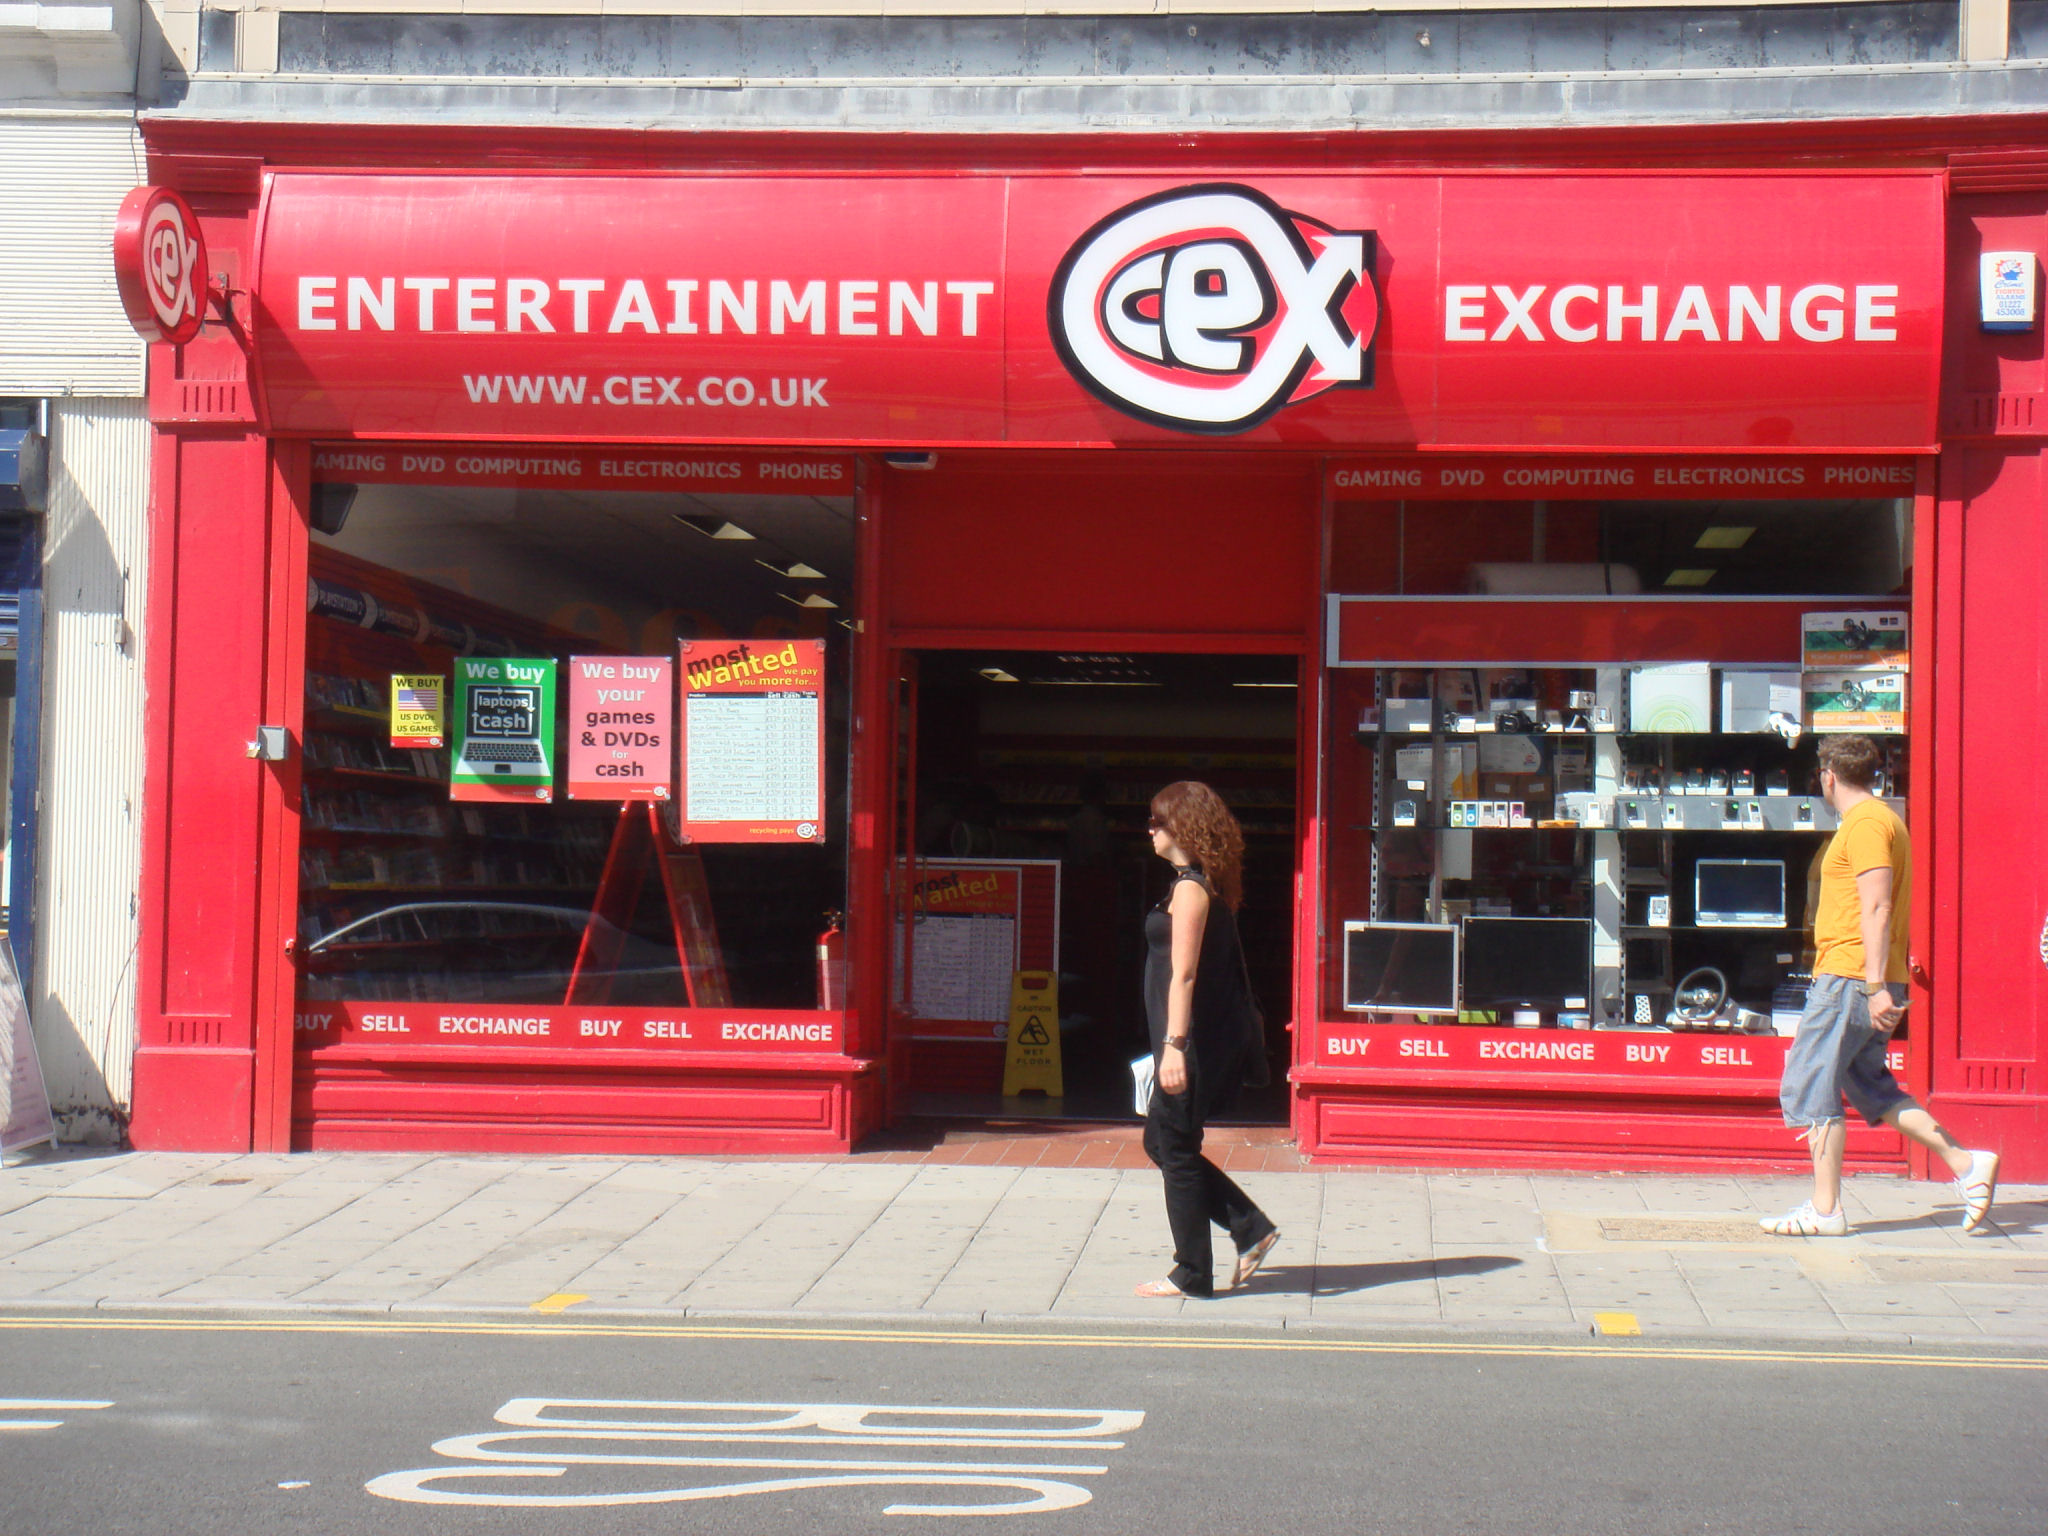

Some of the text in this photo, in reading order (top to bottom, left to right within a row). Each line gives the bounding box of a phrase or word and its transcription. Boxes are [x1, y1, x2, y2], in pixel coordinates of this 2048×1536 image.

[298, 276, 995, 338] ENTERTAINMENT
[1444, 285, 1899, 342] EXCHANGE
[463, 374, 830, 408] WWW.CEX.CO.UK
[314, 454, 843, 480] AMING DVD COMPUTING ELECTRONICS PHONES
[1334, 466, 1915, 487] GAMING DVD COMPUTING ELECTRONICS PHONES
[687, 644, 750, 675] most
[688, 643, 798, 690] wanted
[466, 663, 545, 683] We buy
[582, 663, 661, 683] We buy
[800, 668, 818, 677] pay
[395, 678, 440, 688] WE BUY
[739, 678, 756, 687] you
[759, 677, 793, 686] more
[478, 695, 529, 709] laptops
[597, 689, 645, 705] your
[400, 713, 435, 721] US DVDs
[479, 713, 526, 729] cash
[586, 712, 655, 728] games
[396, 725, 438, 733] US GAMES
[581, 731, 660, 747] & DVDs
[611, 750, 629, 759] for
[595, 762, 644, 777] cash
[749, 827, 778, 835] recycling
[295, 1014, 833, 1042] BUY SELL EXCHANGE BUY SELL EXCHANGE
[1328, 1038, 1752, 1066] BUY SELL EXCHANGE BUY SELL
